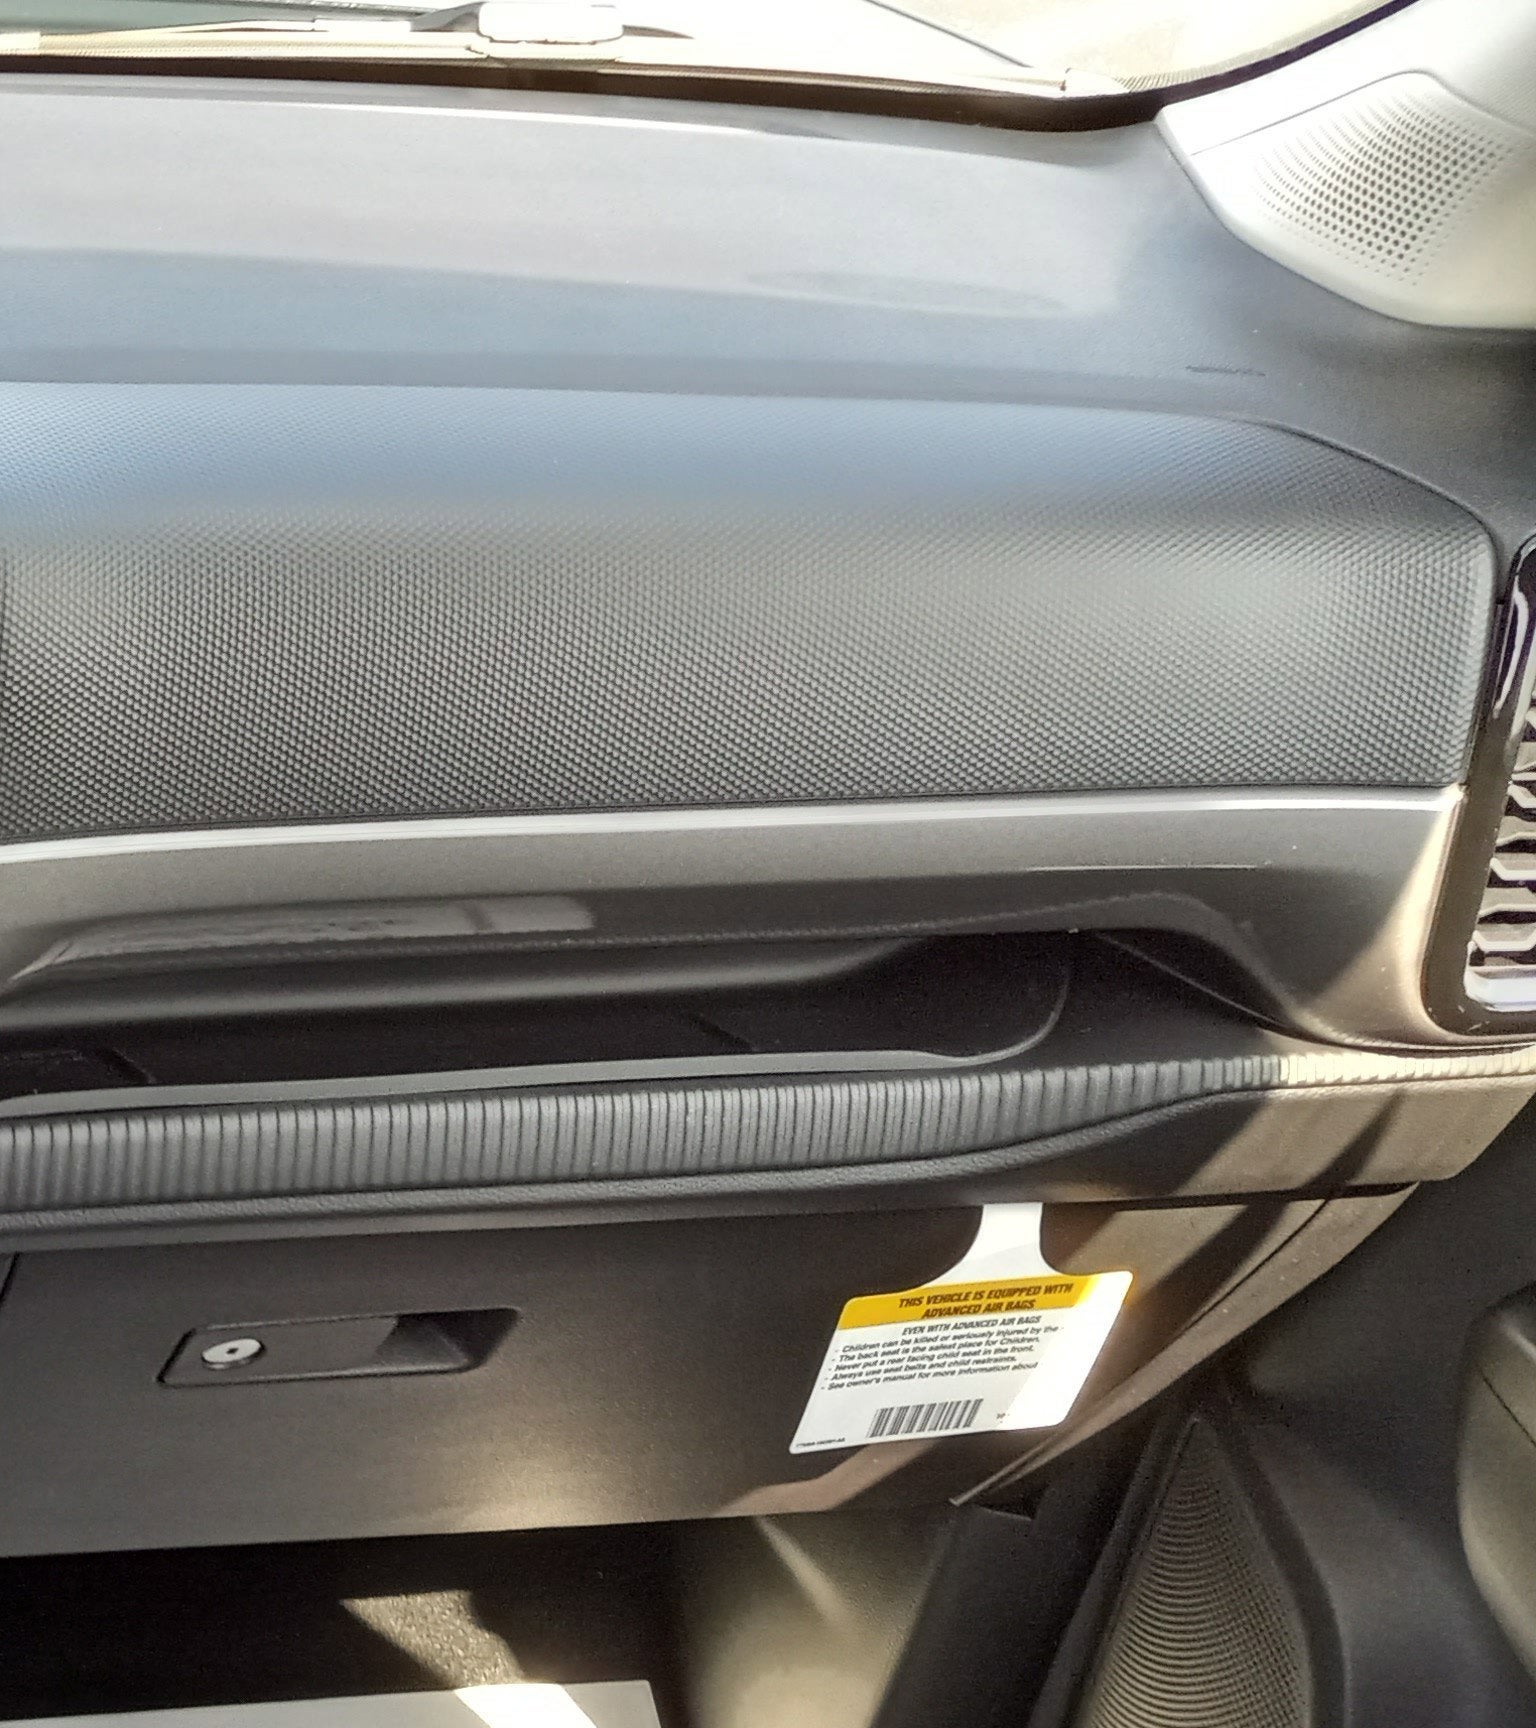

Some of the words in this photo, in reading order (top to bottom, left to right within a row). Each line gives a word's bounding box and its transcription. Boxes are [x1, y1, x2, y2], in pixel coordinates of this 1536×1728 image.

[898, 1296, 924, 1308] THIS
[926, 1291, 972, 1305] VEHICLE
[973, 1290, 984, 1300] IS
[986, 1285, 1041, 1300] EQUIPPED
[1043, 1283, 1074, 1295] WITH
[921, 1303, 980, 1319] ADVANCED
[983, 1301, 1004, 1313] AIR
[1006, 1299, 1037, 1311] BAGS
[902, 1324, 925, 1336] EVEN
[926, 1323, 951, 1333] WITH
[951, 1318, 998, 1330] ADVANCED
[1000, 1316, 1017, 1326] AIR
[1017, 1315, 1042, 1325] BAGS
[842, 1342, 880, 1353] Children
[881, 1340, 898, 1348] can
[900, 1338, 912, 1346] be
[913, 1336, 939, 1344] killed
[952, 1330, 995, 1341] seriously
[996, 1327, 1029, 1338] injured
[1029, 1326, 1041, 1335] by
[1043, 1325, 1059, 1333] the
[857, 1351, 879, 1360] back
[880, 1349, 901, 1357] seat
[911, 1345, 927, 1353] the
[957, 1340, 983, 1350] place
[985, 1339, 998, 1347] for
[831, 1371, 863, 1381] Always
[865, 1369, 882, 1377] use
[883, 1365, 903, 1374] seat
[928, 1361, 947, 1370] and
[947, 1359, 971, 1367] child
[834, 1363, 861, 1372] Never
[862, 1359, 879, 1369] put
[886, 1356, 906, 1365] rear
[907, 1353, 935, 1363] facing
[936, 1351, 960, 1360] child
[961, 1348, 982, 1357] seat
[982, 1347, 992, 1355] in
[993, 1346, 1009, 1354] the
[828, 1382, 845, 1391] See
[882, 1372, 917, 1383] manual
[917, 1370, 931, 1379] for
[932, 1369, 956, 1378] more
[957, 1364, 1010, 1375] information
